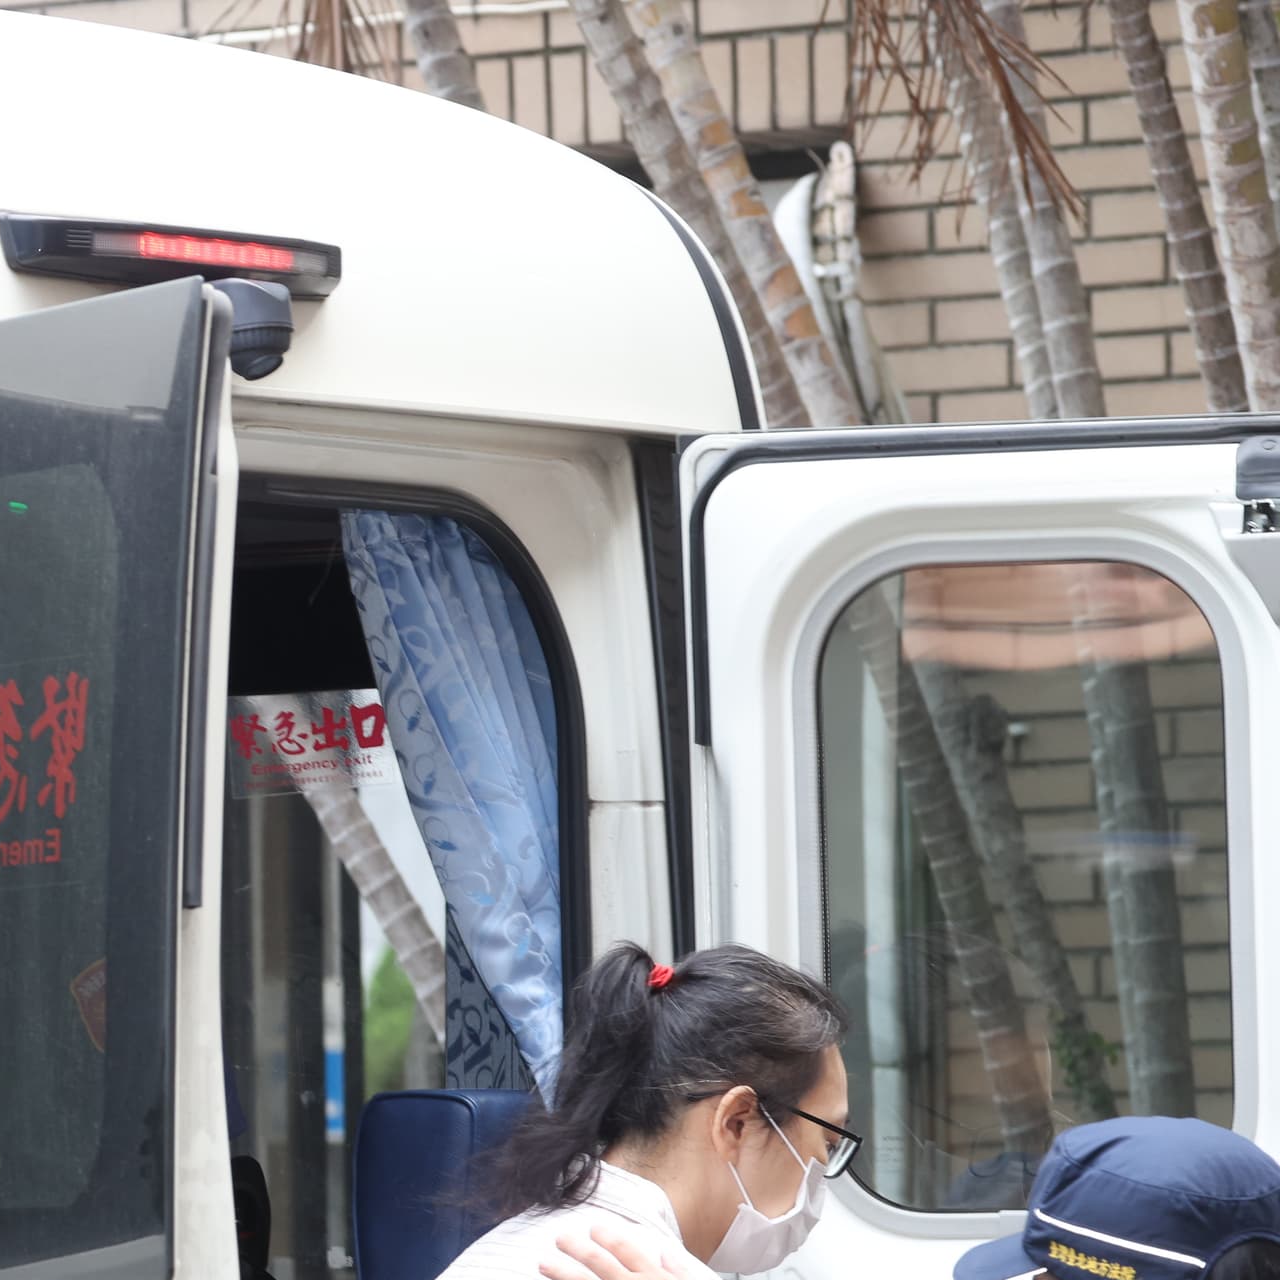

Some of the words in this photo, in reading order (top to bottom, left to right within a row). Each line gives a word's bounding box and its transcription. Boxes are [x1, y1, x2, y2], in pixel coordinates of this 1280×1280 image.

[228, 703, 387, 760] 緊急出口
[344, 753, 373, 768] exit
